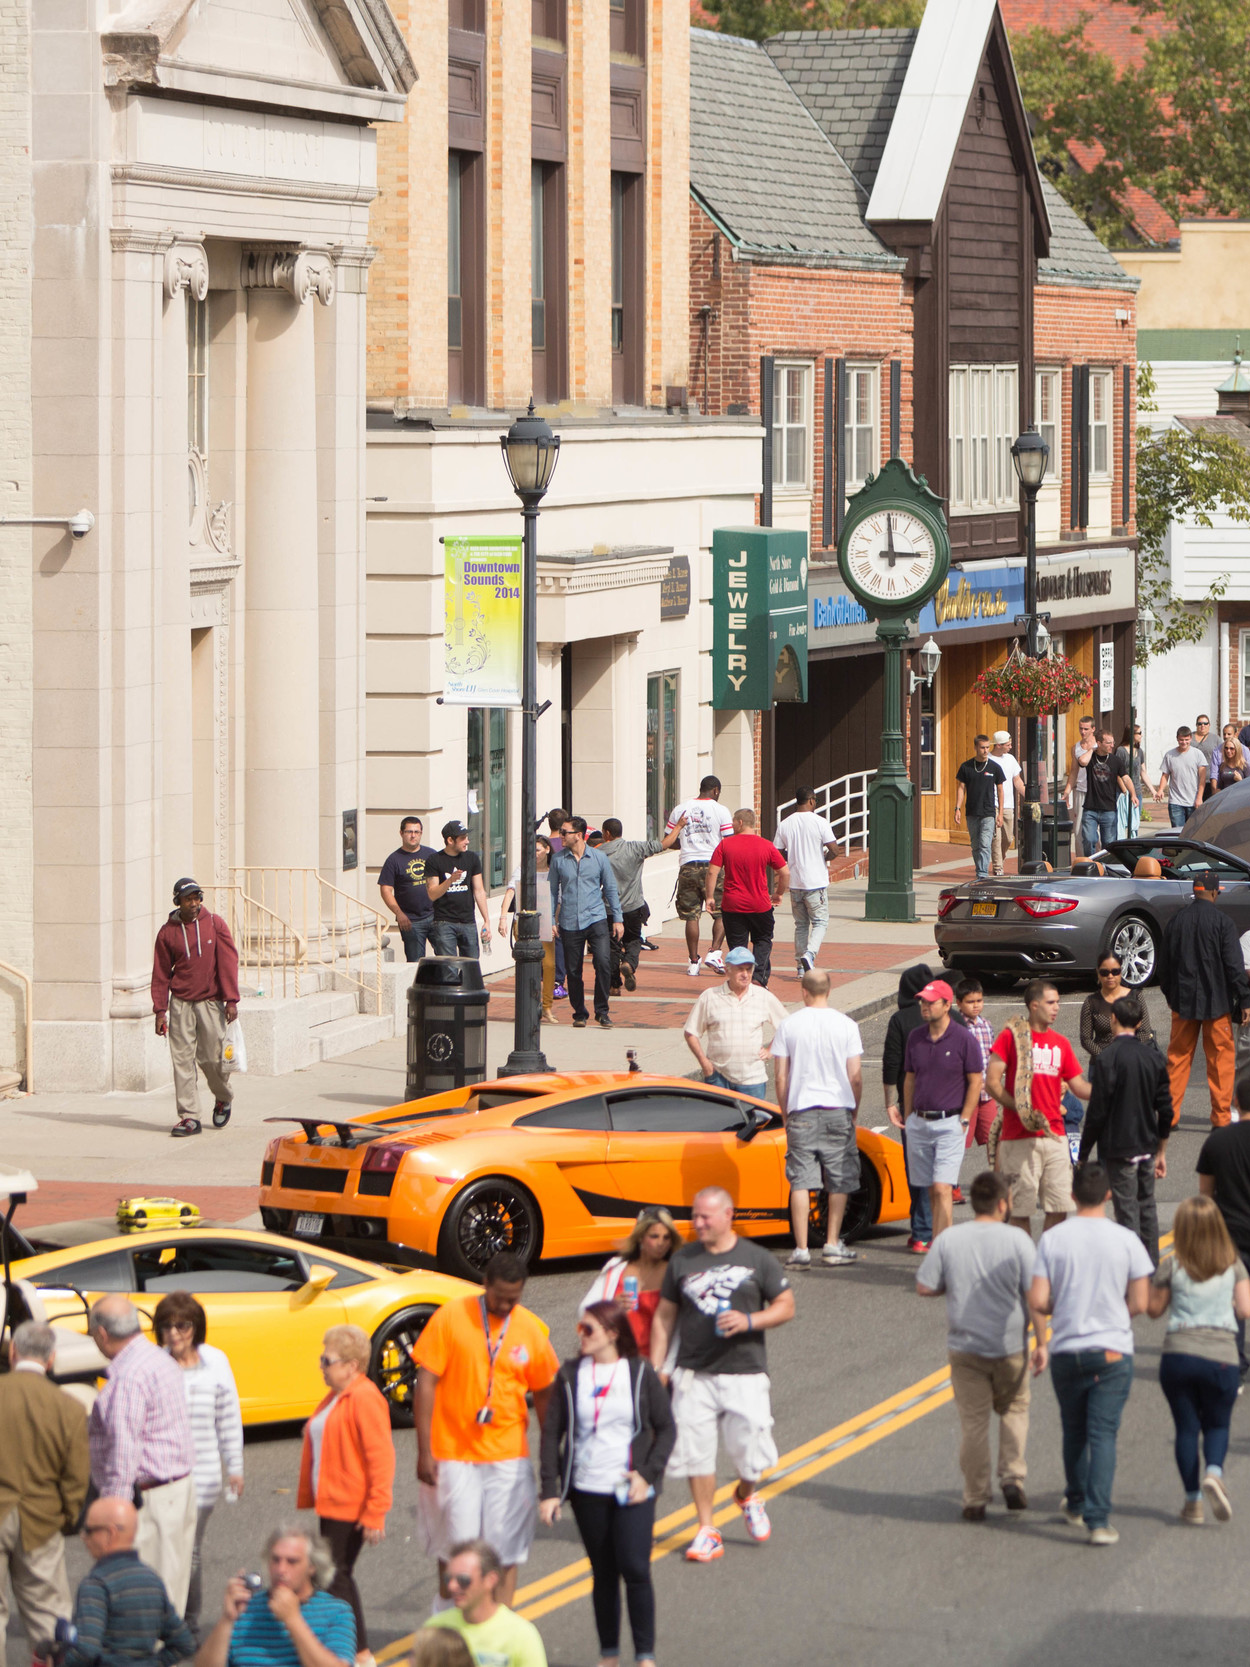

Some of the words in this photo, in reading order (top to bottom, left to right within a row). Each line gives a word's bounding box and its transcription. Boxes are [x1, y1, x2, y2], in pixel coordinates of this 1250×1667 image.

[463, 561, 520, 573] Downtown
[463, 574, 504, 585] Sounds
[769, 578, 779, 595] Gold
[494, 587, 520, 599] 2014
[727, 550, 749, 692] JEWELRY
